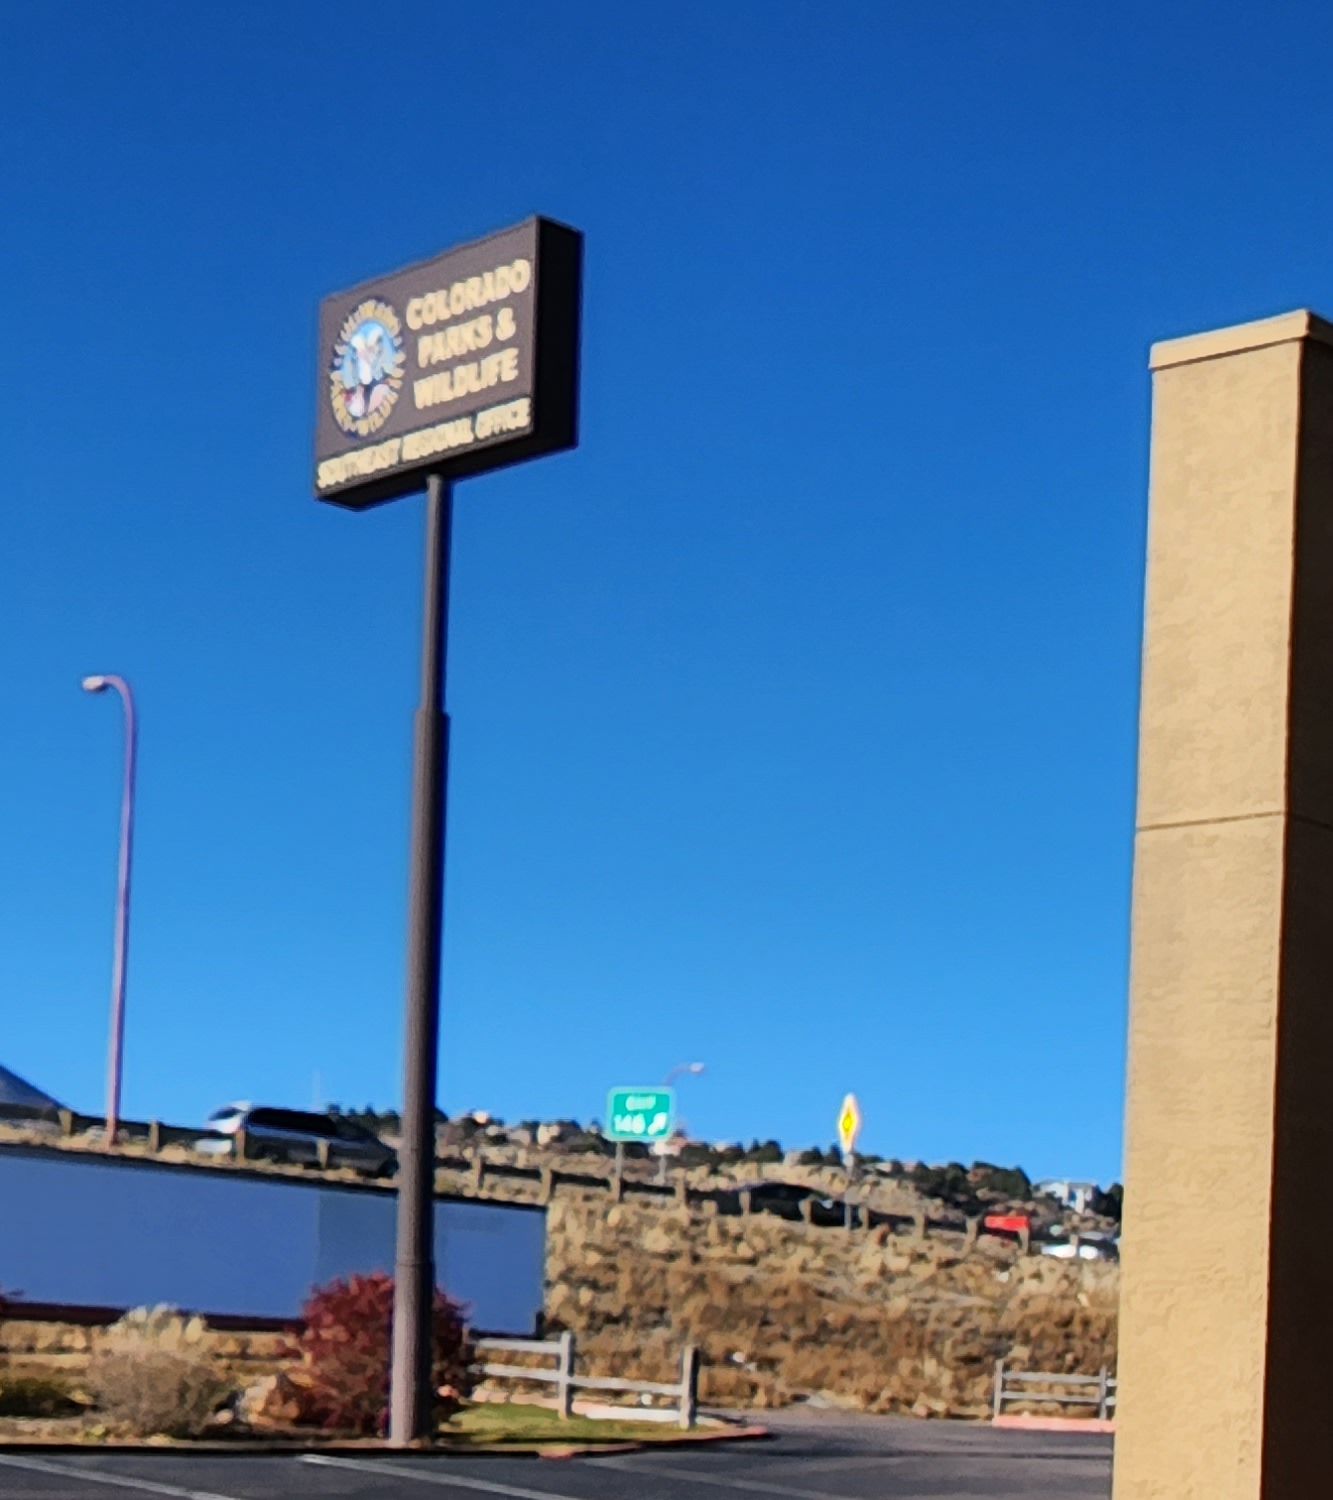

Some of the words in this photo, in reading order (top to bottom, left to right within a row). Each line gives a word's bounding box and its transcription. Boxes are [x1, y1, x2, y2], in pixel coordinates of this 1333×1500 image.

[406, 259, 531, 330] COLORADO
[418, 315, 492, 368] PARKS
[413, 348, 519, 409] WILDLIFE
